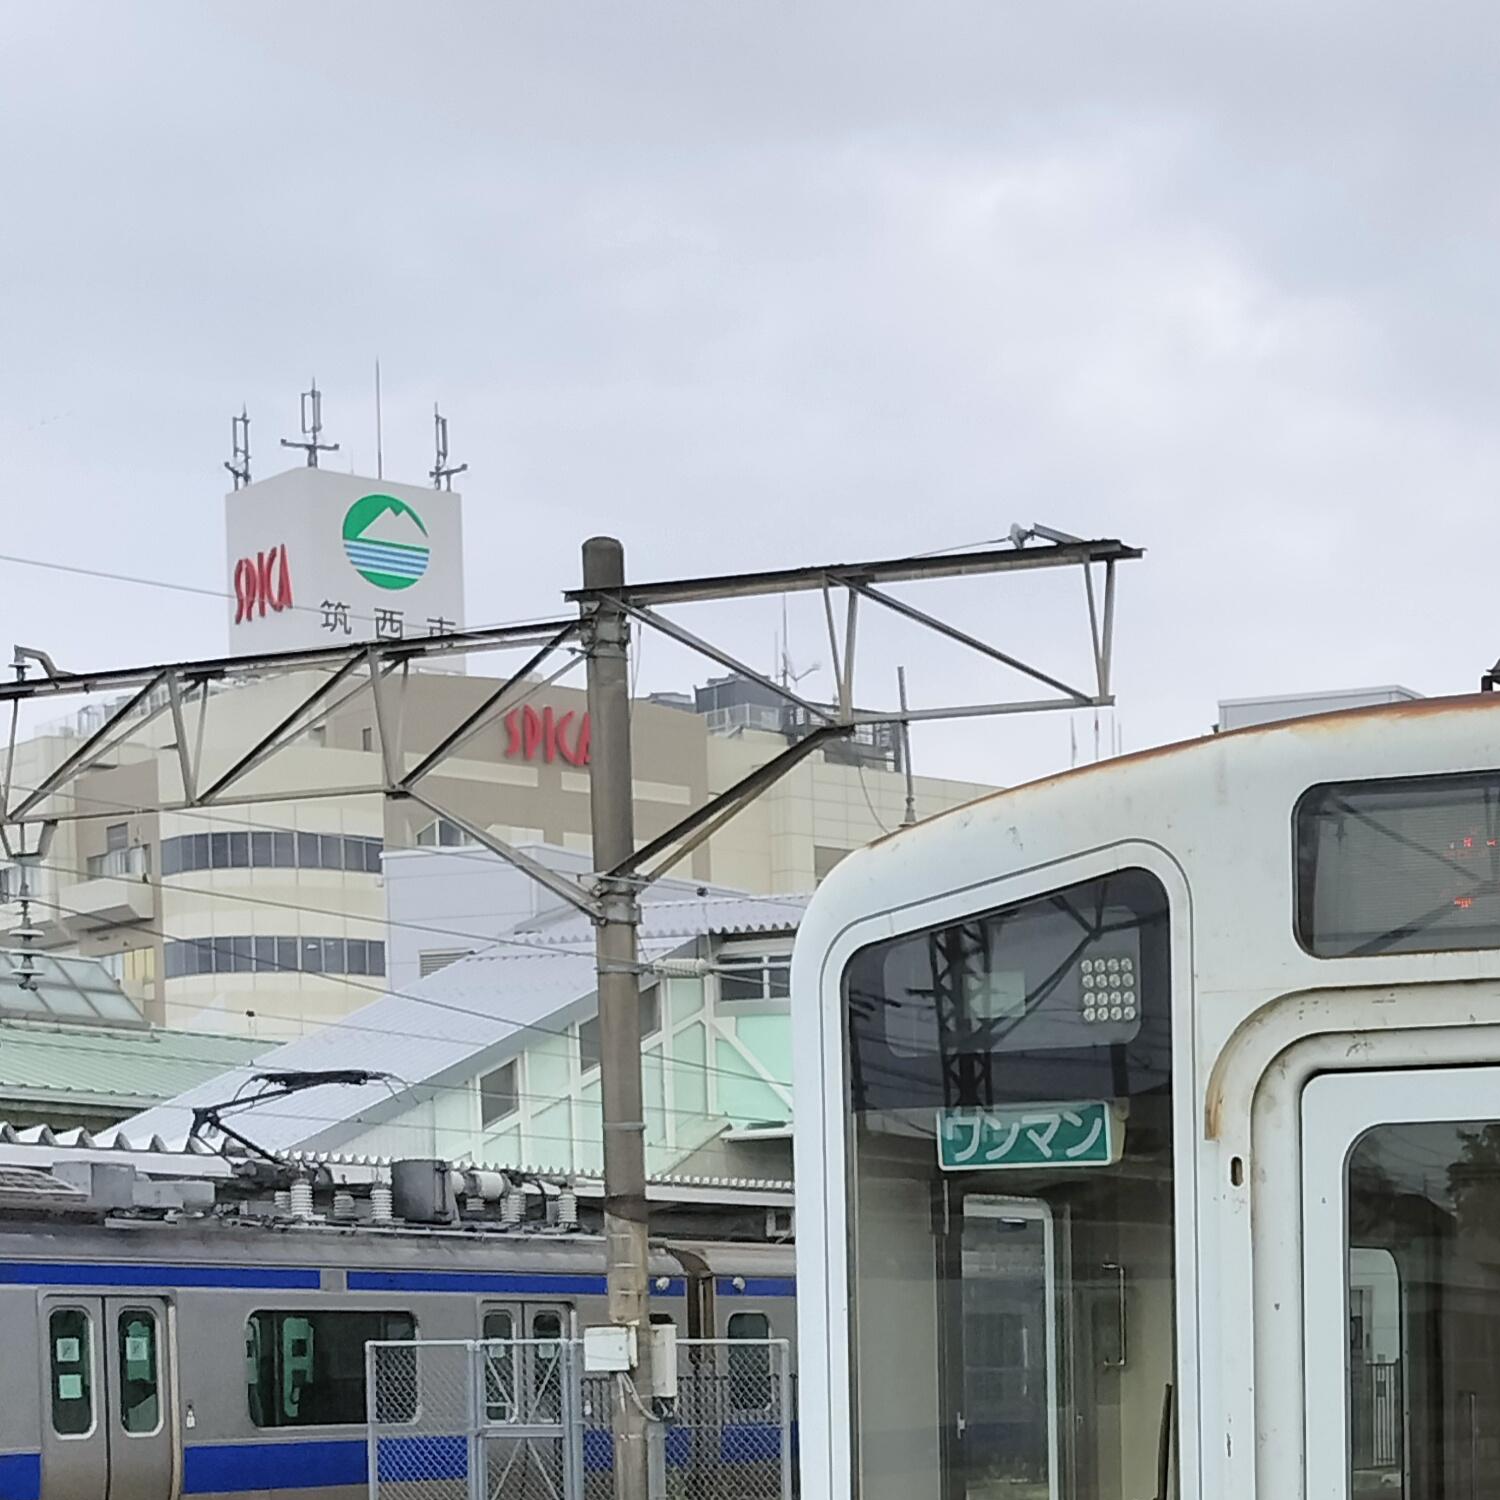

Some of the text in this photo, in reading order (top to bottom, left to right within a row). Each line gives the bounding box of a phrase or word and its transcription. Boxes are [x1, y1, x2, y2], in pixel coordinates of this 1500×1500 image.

[234, 543, 293, 625] SPICA
[946, 1110, 1103, 1163] ワンマン
